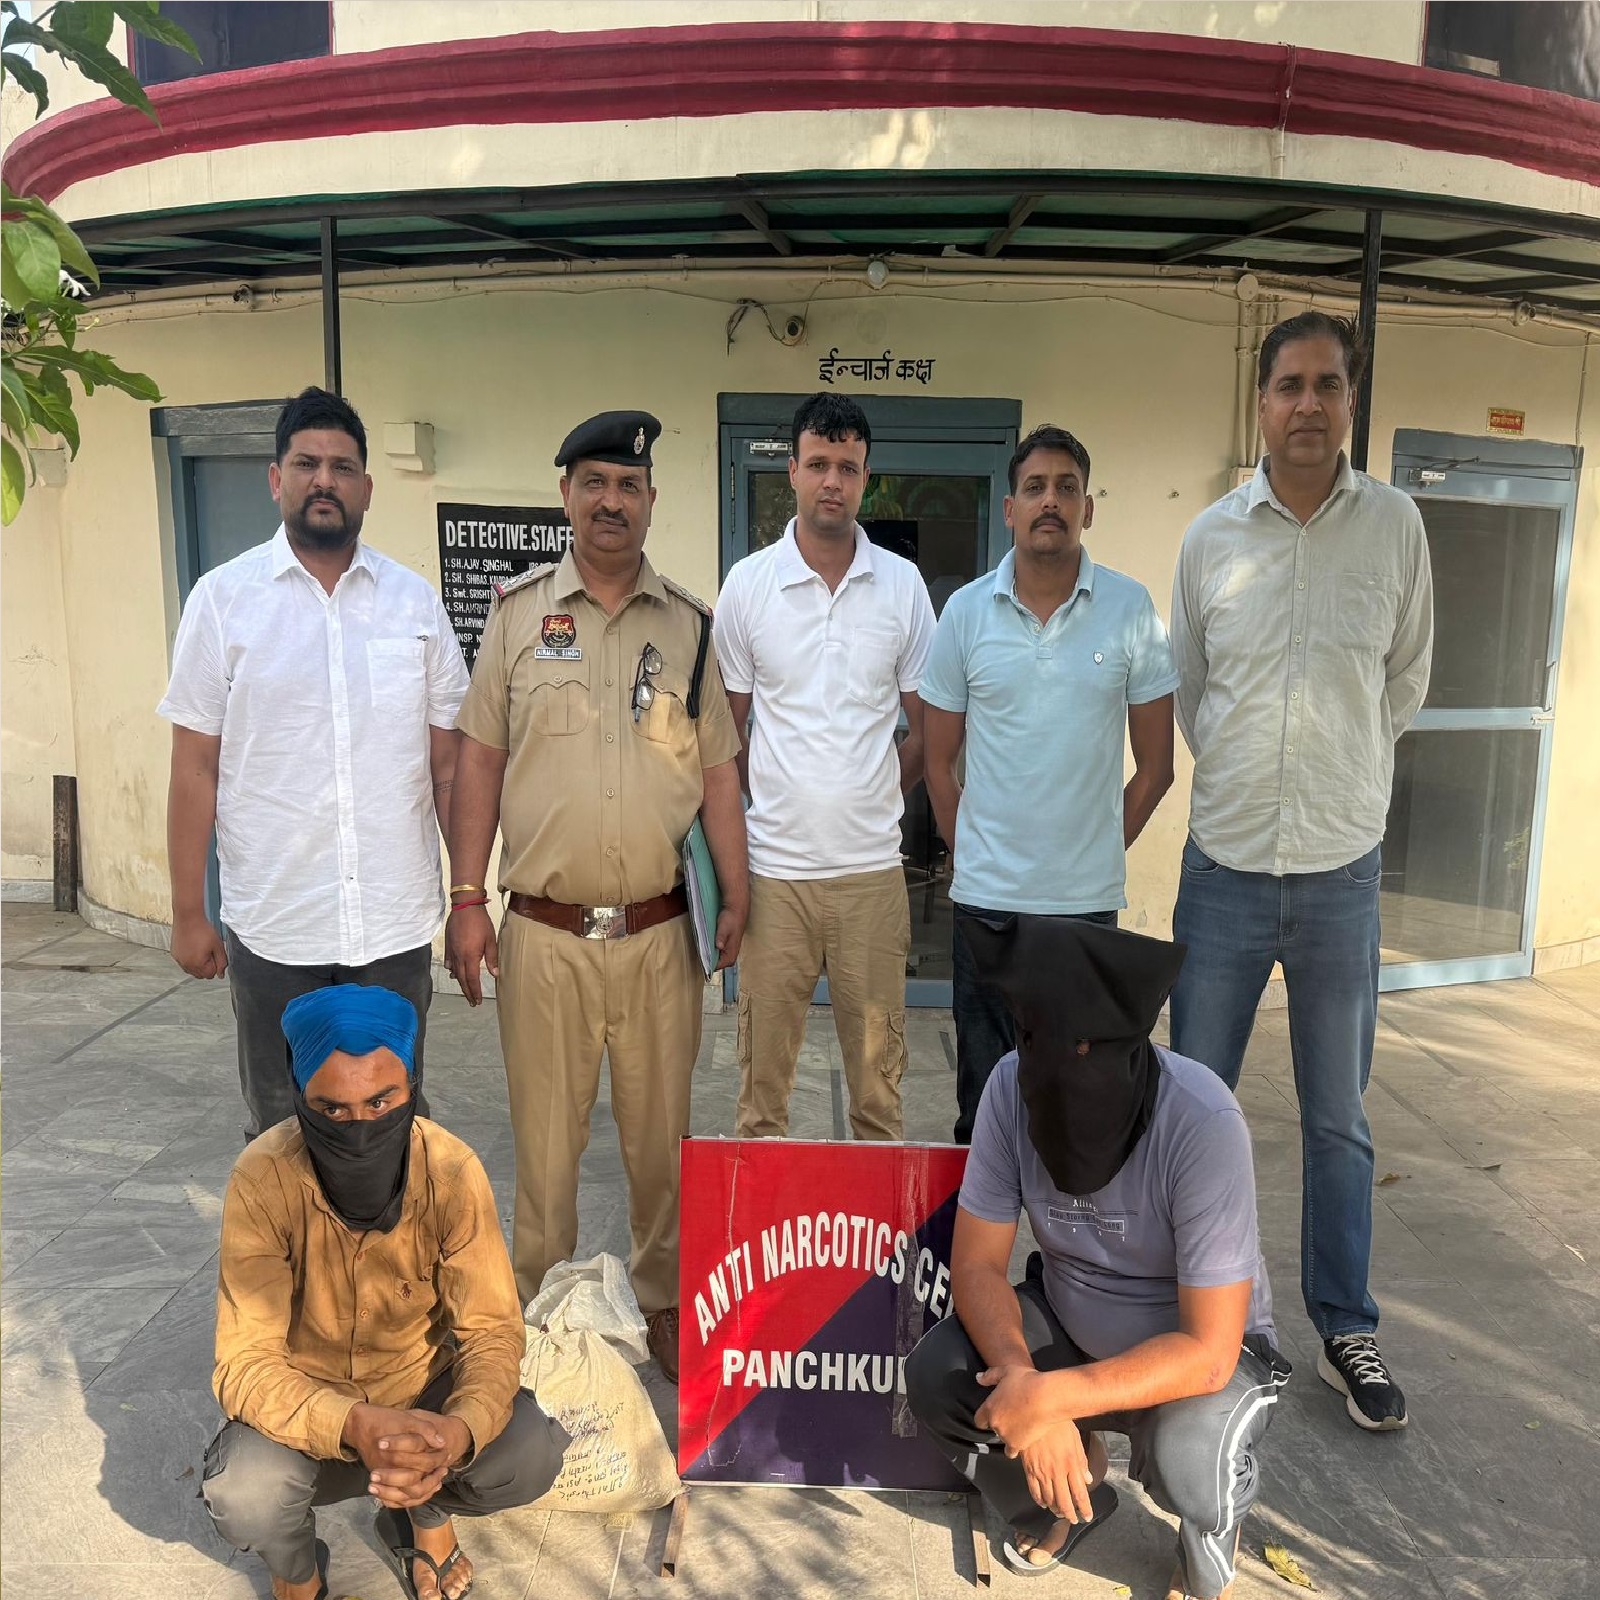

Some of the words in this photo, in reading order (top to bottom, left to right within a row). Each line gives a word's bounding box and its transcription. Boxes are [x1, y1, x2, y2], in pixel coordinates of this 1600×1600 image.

[895, 358, 936, 385] कक्ष
[469, 588, 491, 600] SRISHT
[694, 1241, 754, 1346] ANTI
[761, 1211, 908, 1284] NARCOTICS
